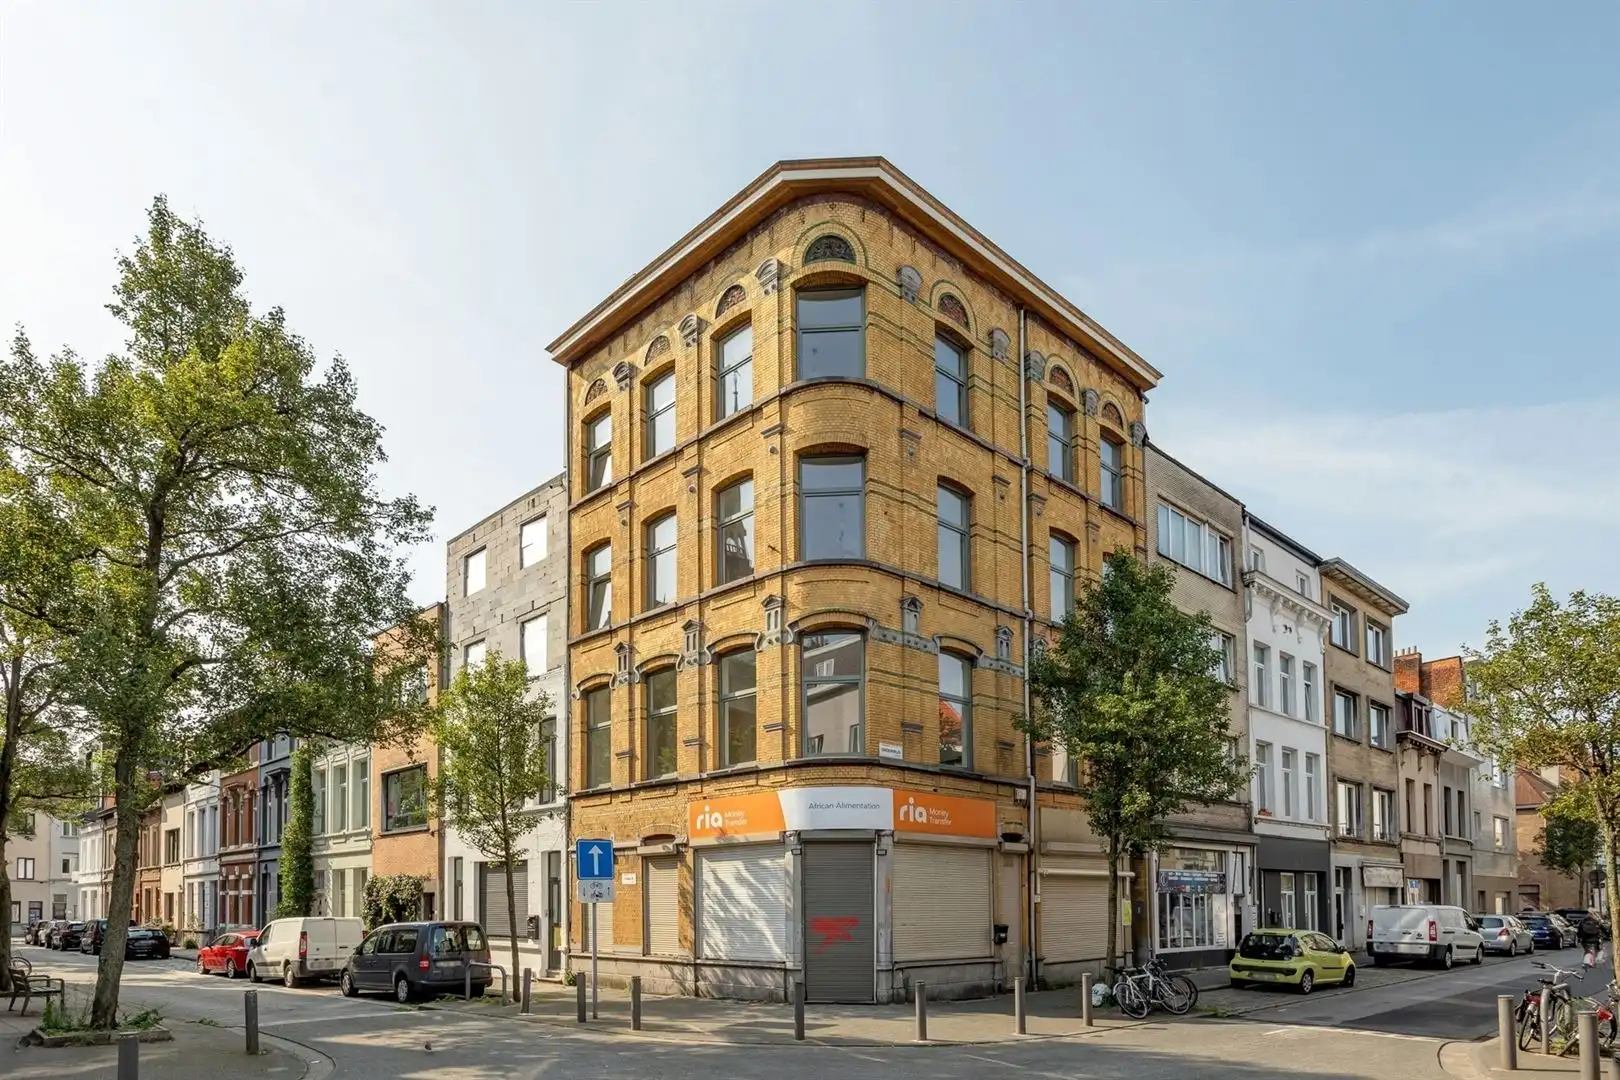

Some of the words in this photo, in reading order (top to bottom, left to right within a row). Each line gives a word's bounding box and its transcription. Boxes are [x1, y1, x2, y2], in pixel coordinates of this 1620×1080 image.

[808, 802, 834, 810] African
[836, 801, 880, 810] Alimentation
[900, 796, 927, 823] ria
[929, 807, 949, 820] Money
[696, 804, 723, 830] ria
